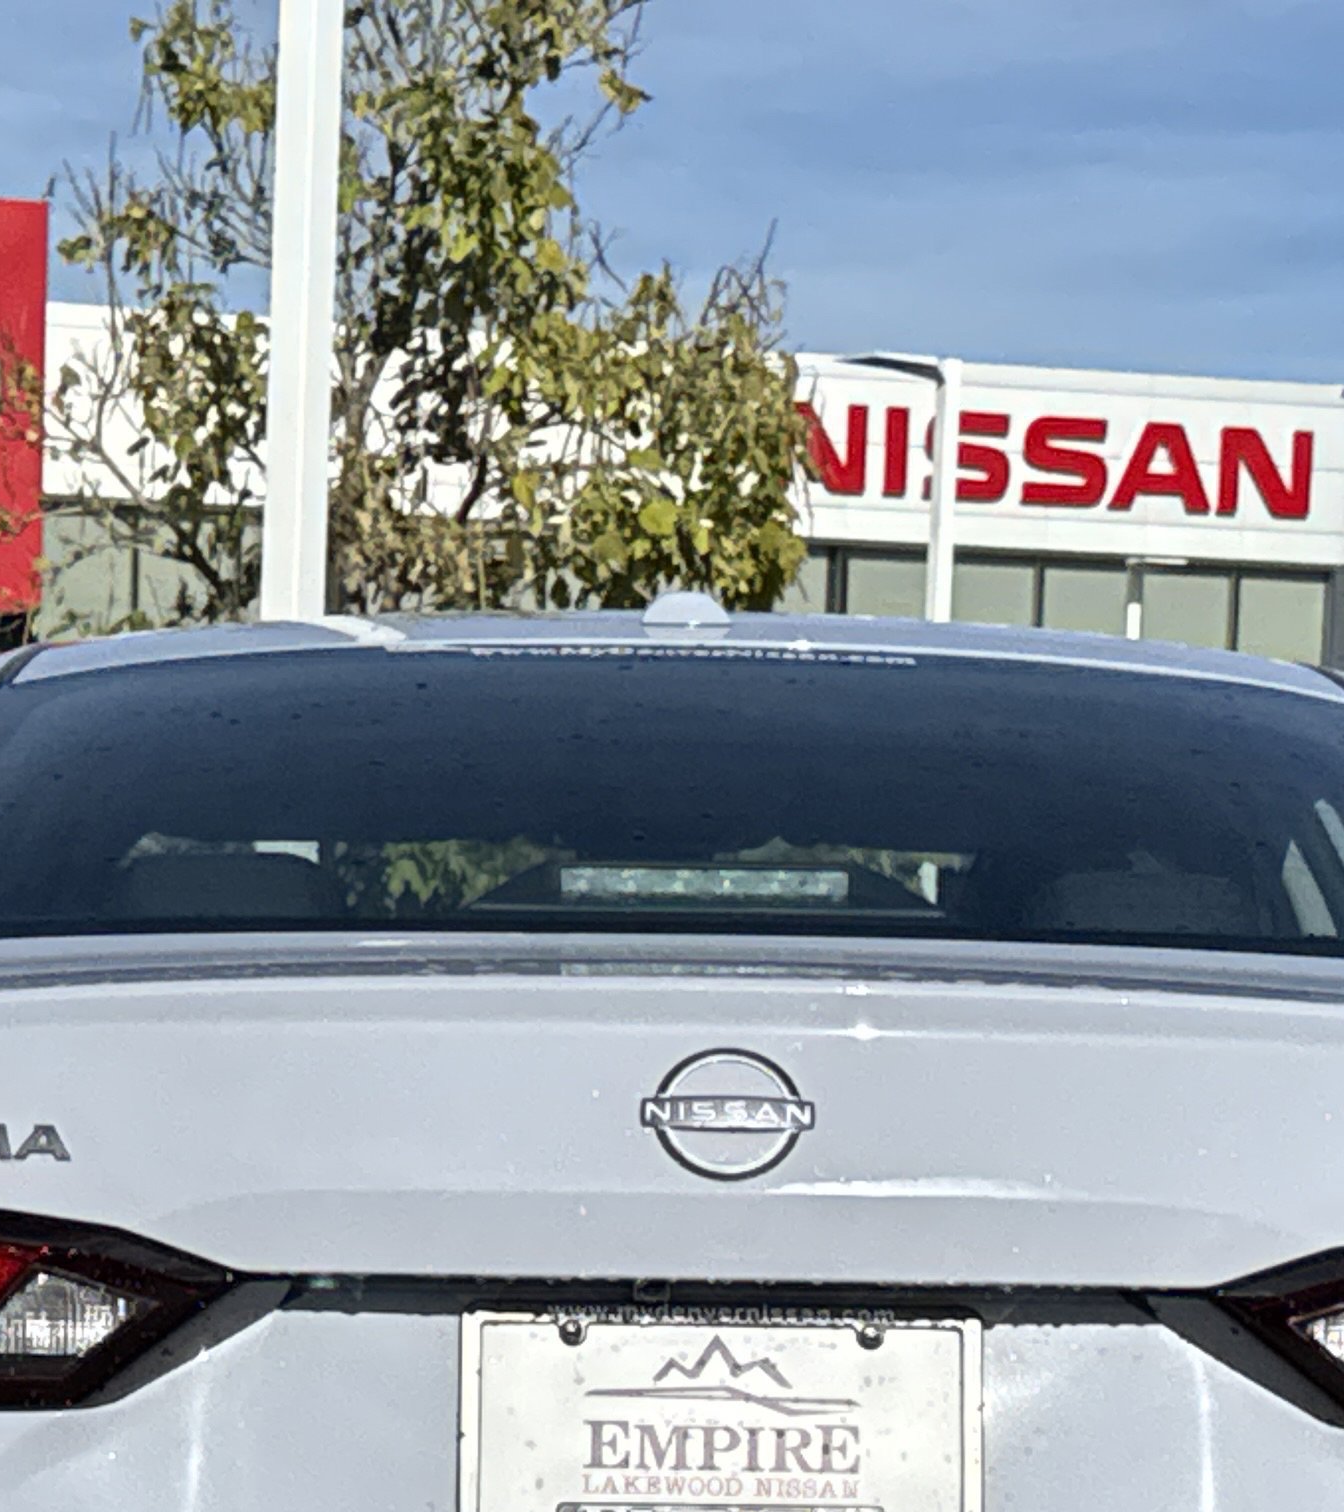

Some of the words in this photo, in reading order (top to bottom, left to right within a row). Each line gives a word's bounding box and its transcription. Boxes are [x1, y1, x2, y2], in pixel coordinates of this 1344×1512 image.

[794, 401, 1314, 521] NISSAN
[644, 1101, 813, 1126] NISSAN
[582, 1419, 860, 1474] EMPIRE
[582, 1474, 744, 1497] LAKEWOOD
[754, 1477, 860, 1499] NISSAN
